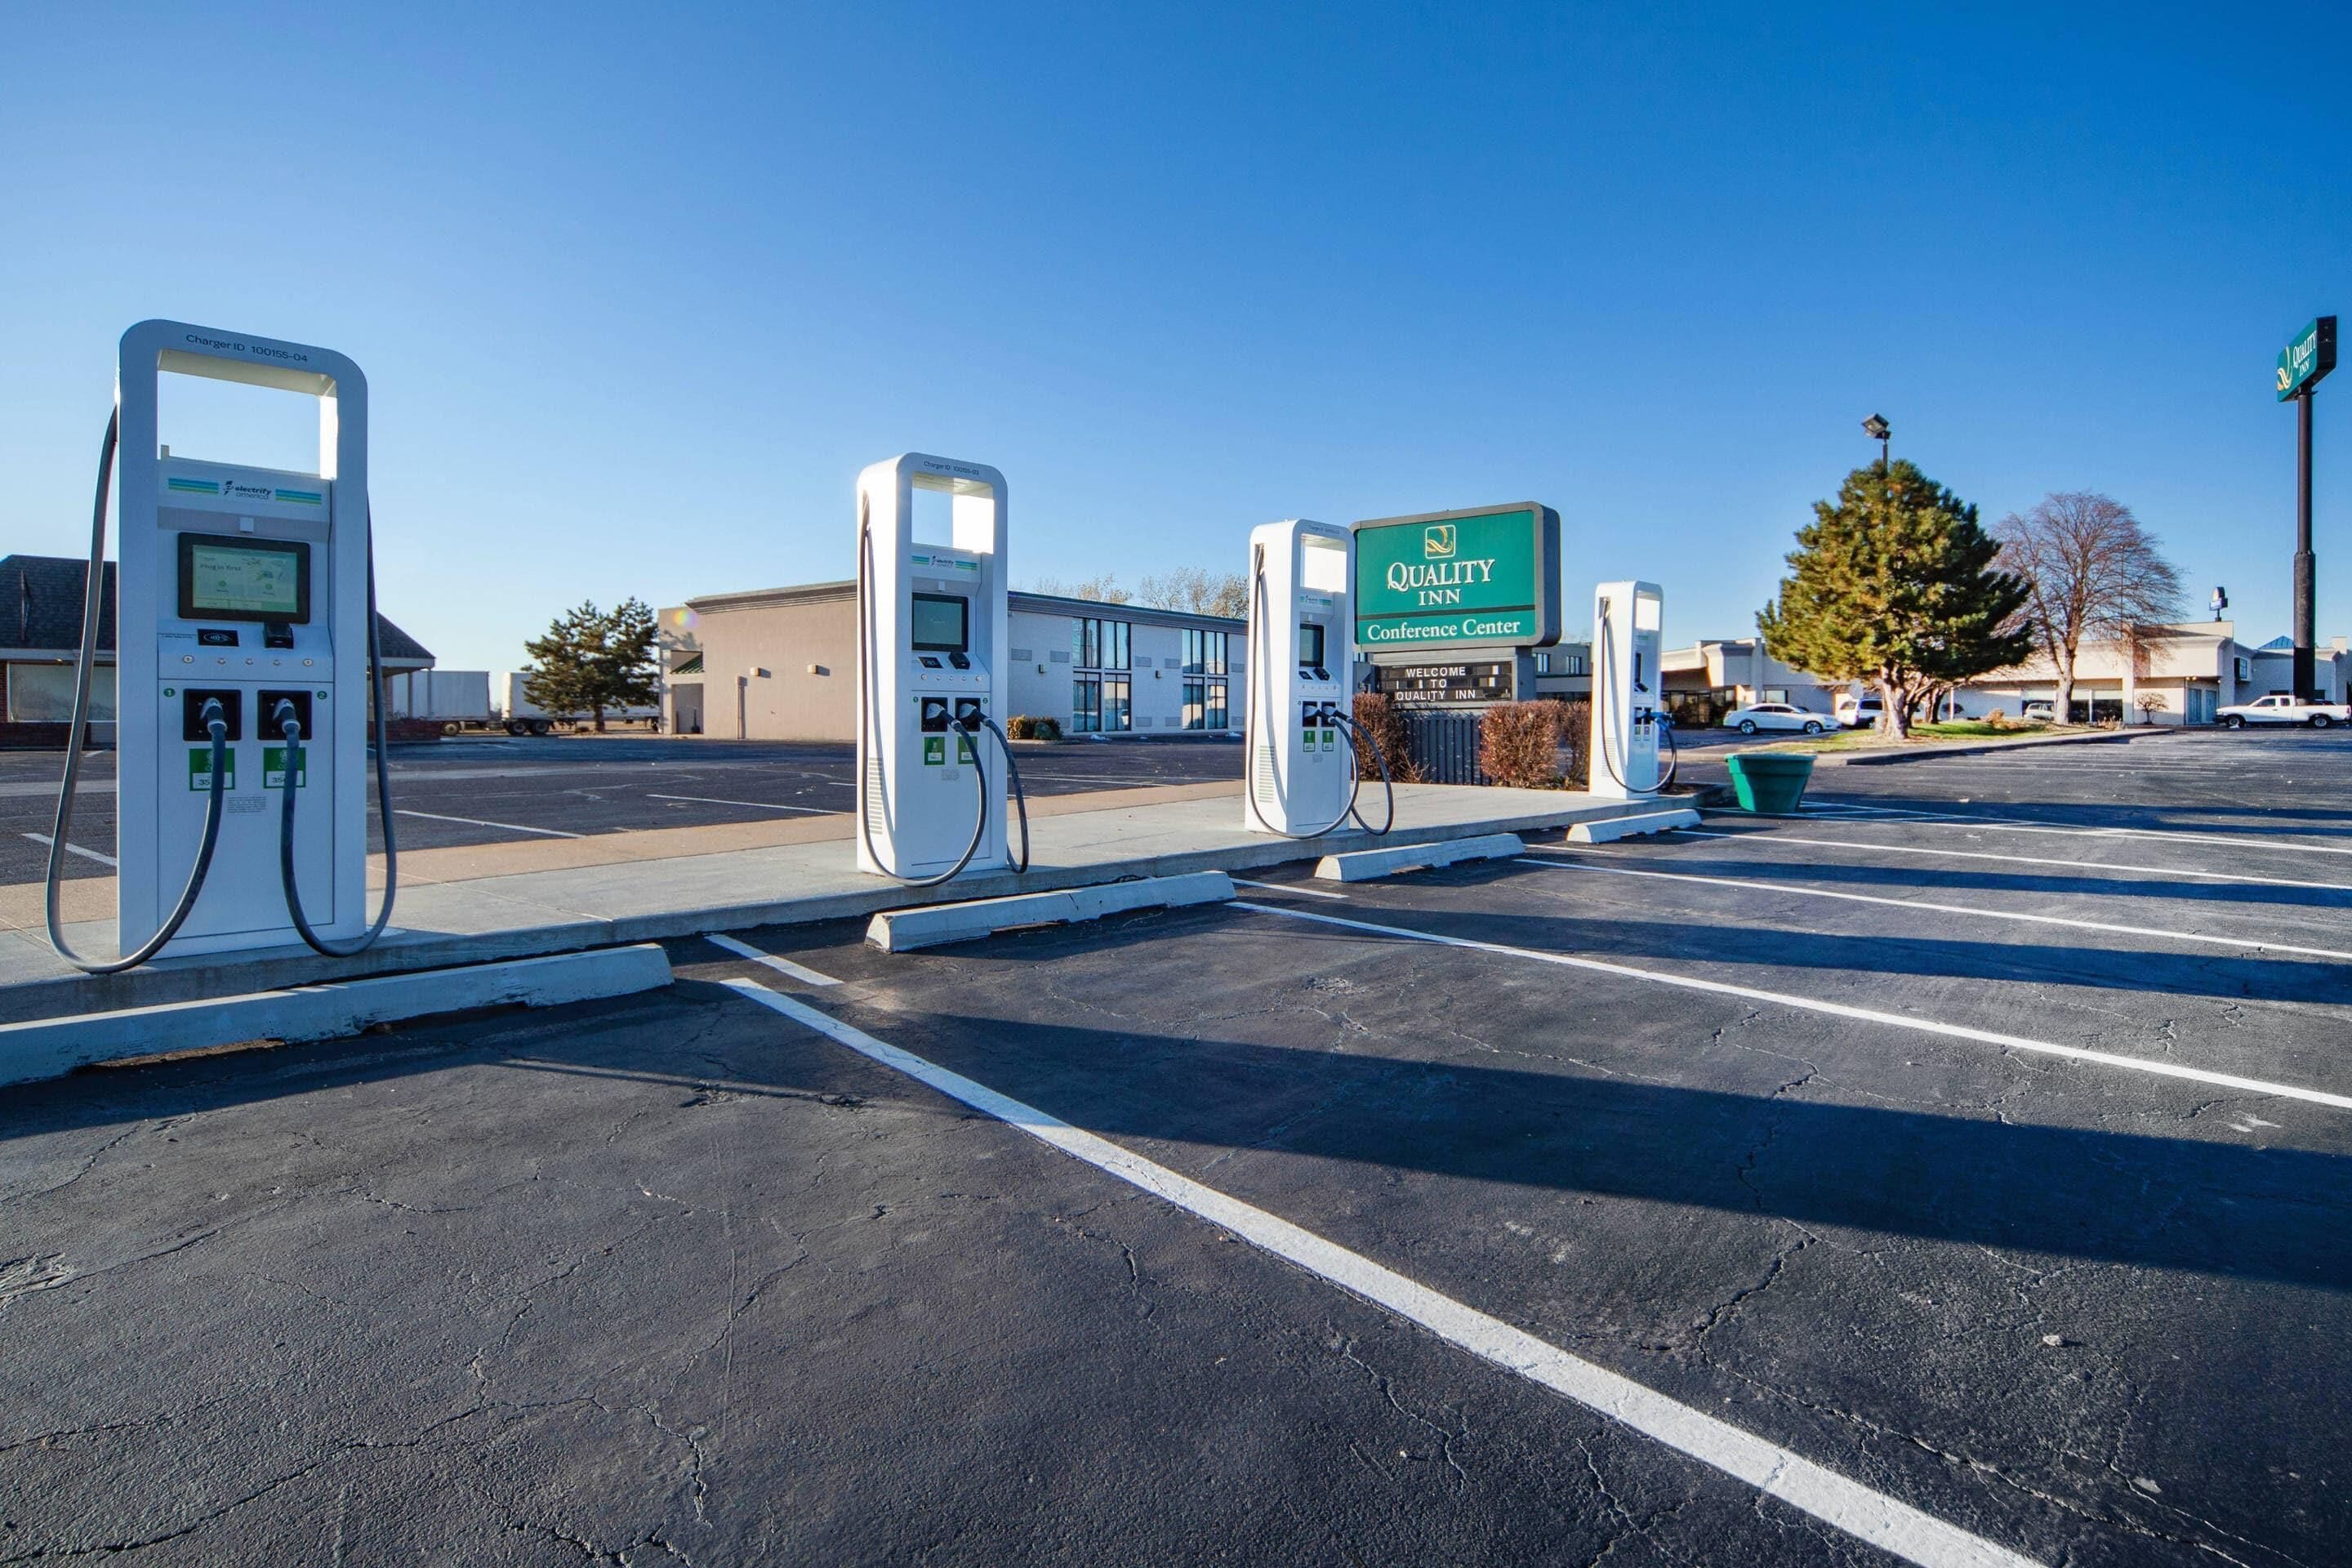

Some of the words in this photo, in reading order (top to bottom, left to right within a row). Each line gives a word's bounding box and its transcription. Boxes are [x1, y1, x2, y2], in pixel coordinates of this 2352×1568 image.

[186, 334, 231, 349] Charger
[234, 343, 245, 351] ID
[252, 345, 308, 362] 100155-04
[2293, 330, 2317, 368] QUALITY
[2300, 359, 2310, 376] INN
[924, 461, 944, 470] Charger
[235, 485, 272, 495] electrify
[236, 492, 269, 501] america
[1388, 559, 1495, 592] QUALITY
[1419, 589, 1460, 606] INN
[1368, 622, 1458, 641] Conference
[1463, 619, 1521, 636] Center
[1405, 666, 1466, 678] WELCOME
[1430, 679, 1447, 688] TO
[1396, 690, 1446, 702] QUALITY
[1455, 689, 1476, 700] INN
